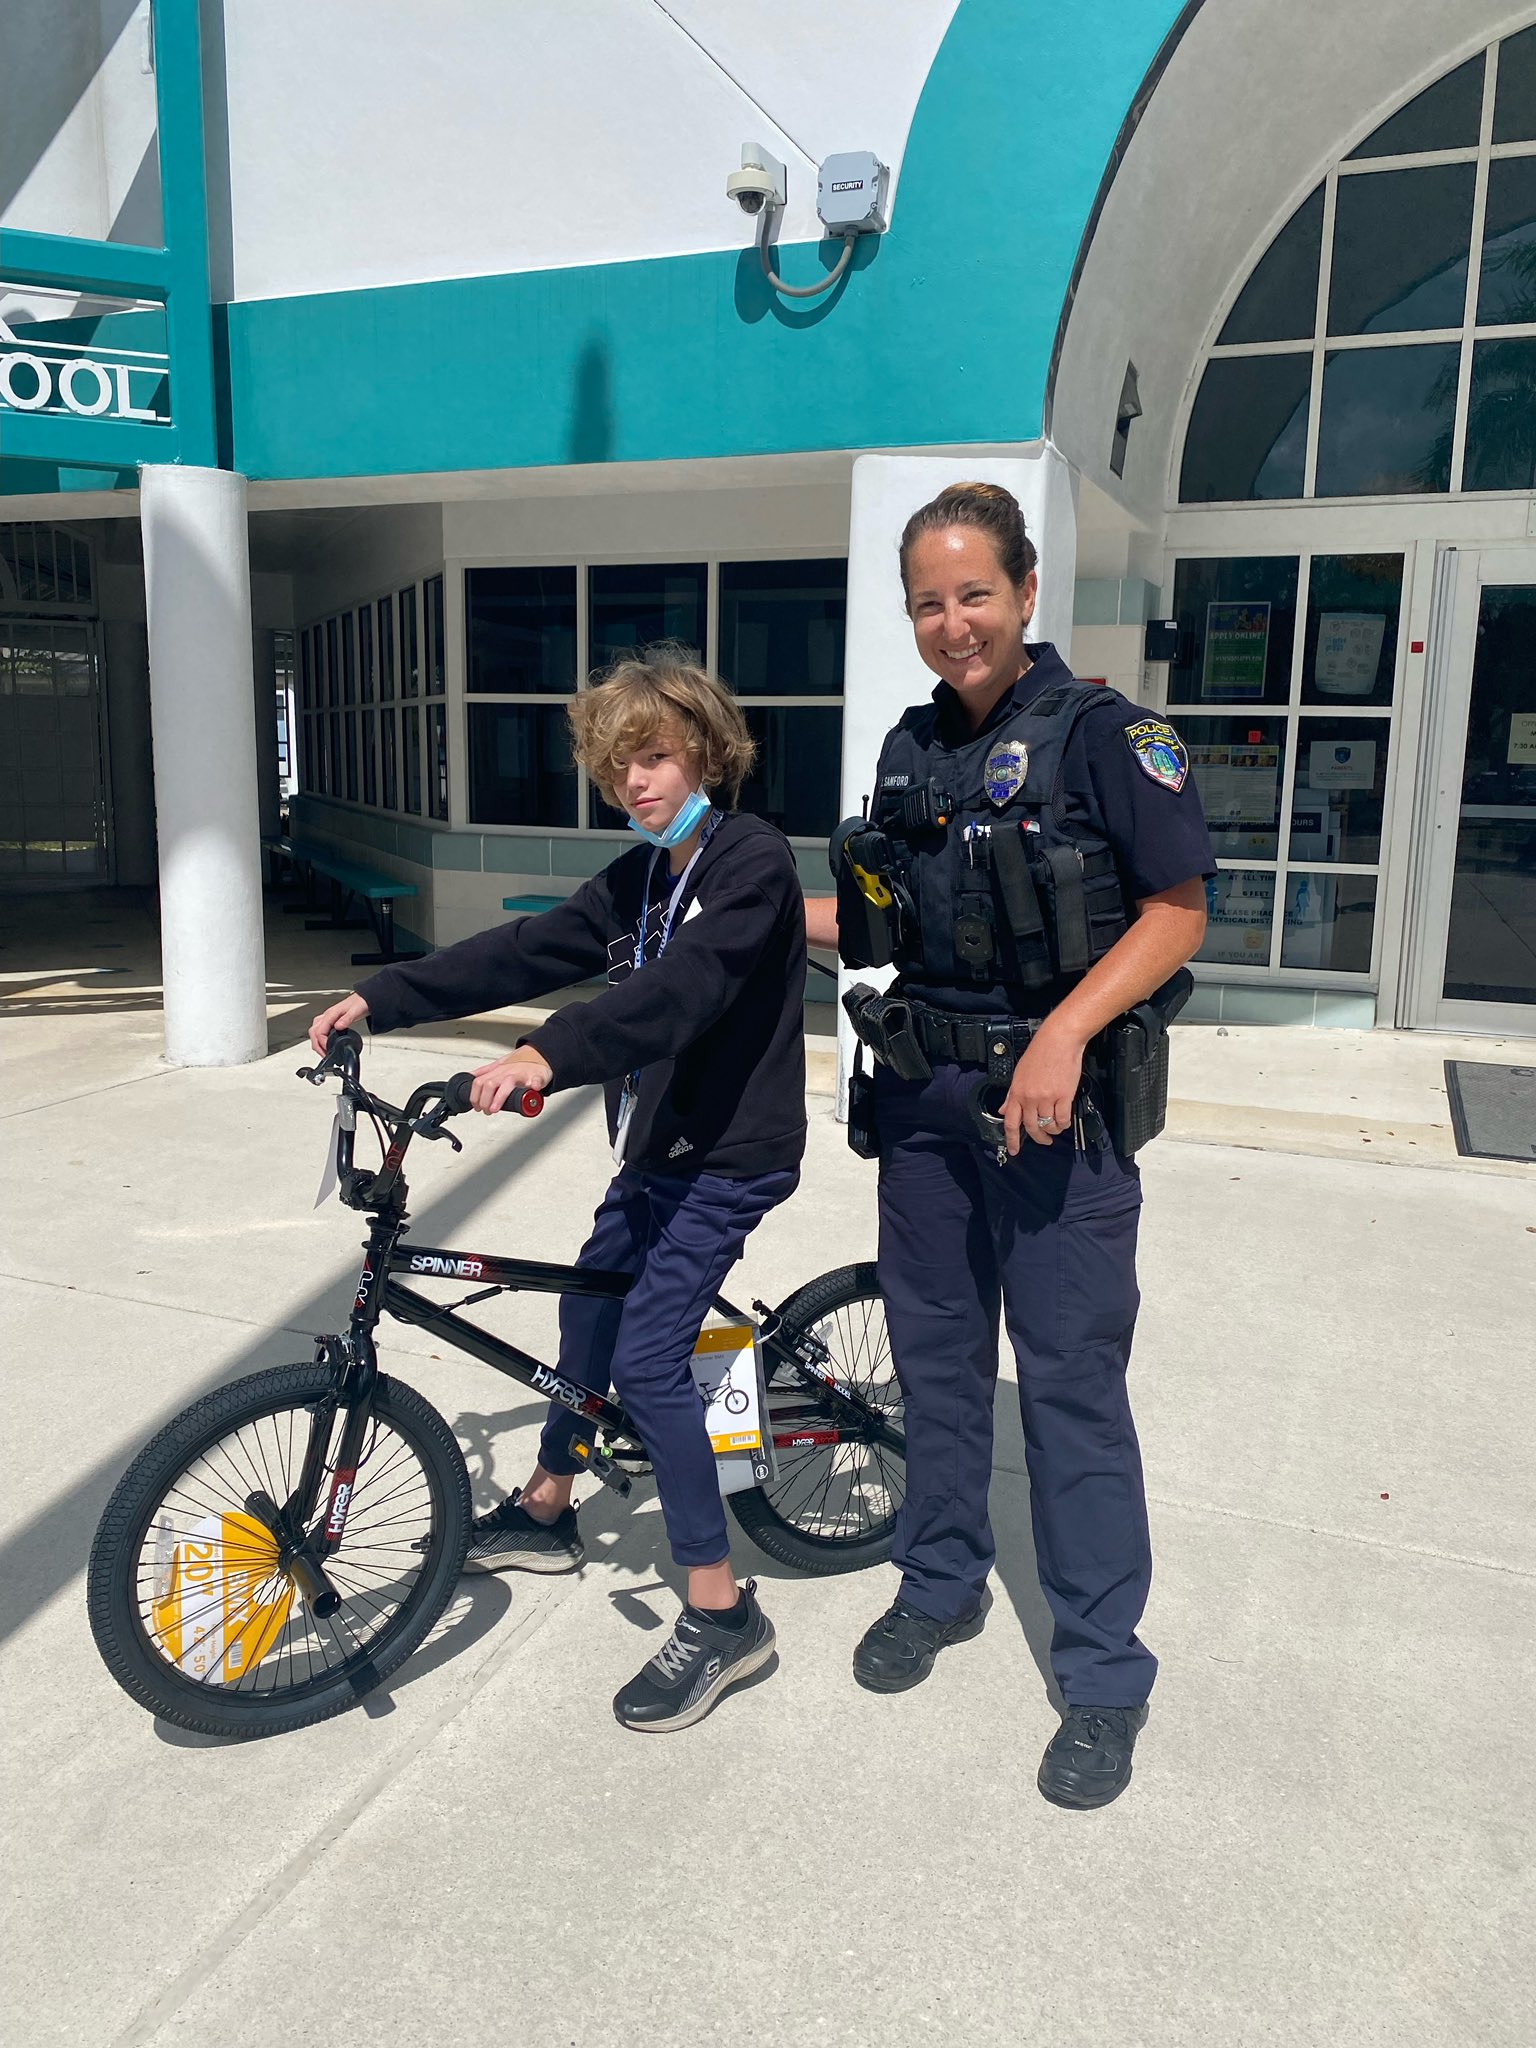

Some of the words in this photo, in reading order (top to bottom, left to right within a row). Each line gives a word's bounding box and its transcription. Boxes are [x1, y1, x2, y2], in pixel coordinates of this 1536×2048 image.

[832, 181, 863, 192] SECURITY
[1129, 724, 1172, 740] POLICE
[1136, 737, 1154, 748] CORAL
[884, 775, 909, 787] SANFORD
[669, 1144, 693, 1158] adidas
[410, 1254, 483, 1278] SPINNER
[227, 1571, 250, 1627] BMX
